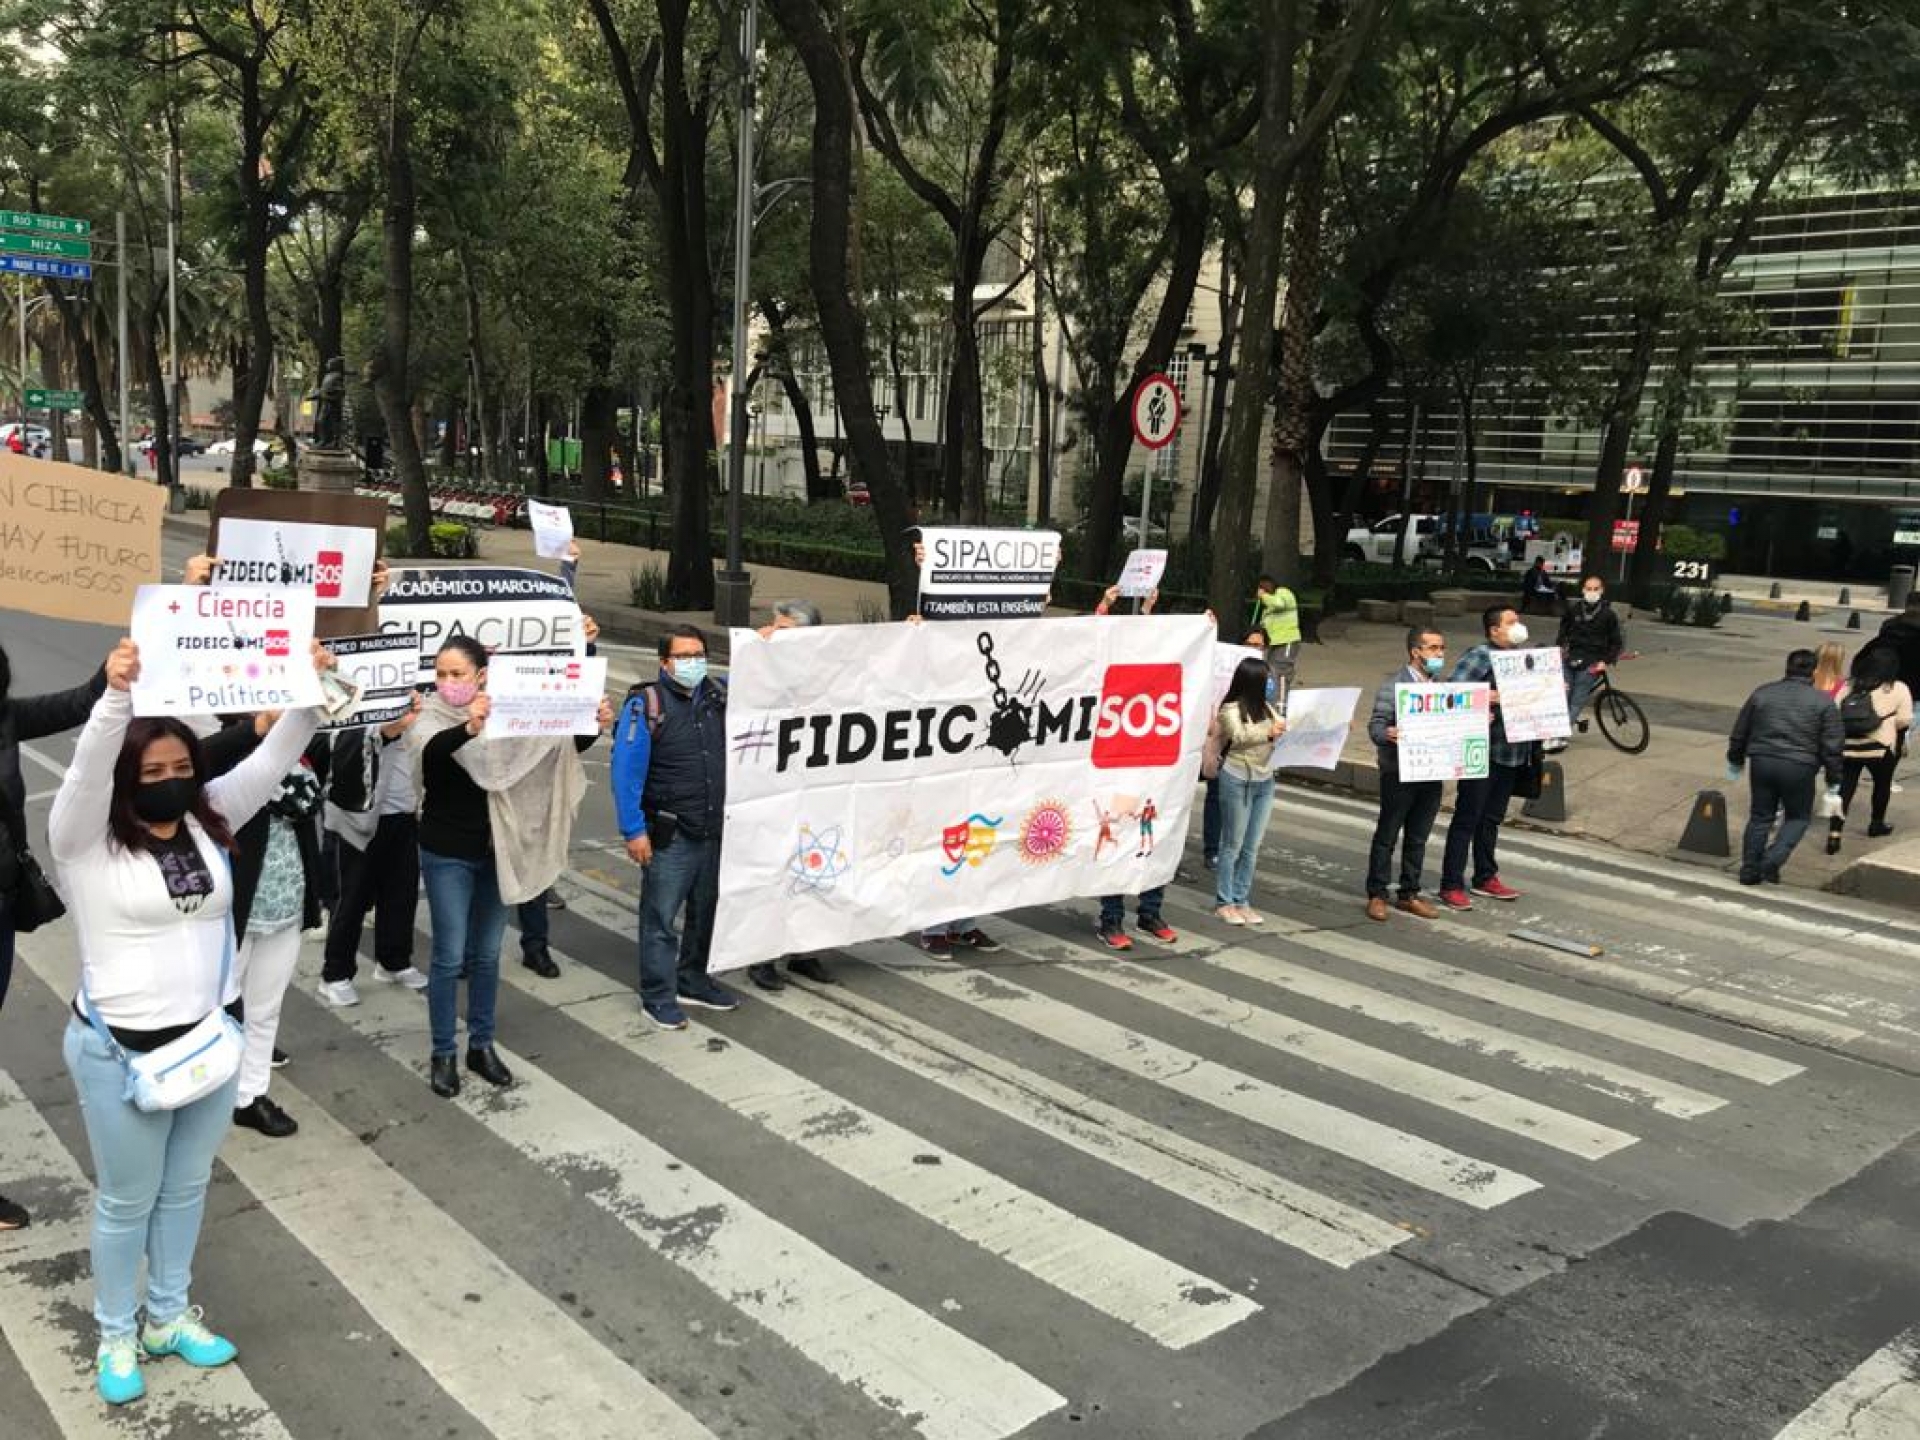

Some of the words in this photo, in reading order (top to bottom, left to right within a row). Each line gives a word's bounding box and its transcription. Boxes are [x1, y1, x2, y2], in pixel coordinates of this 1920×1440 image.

[13, 215, 30, 225] RIO
[32, 239, 61, 251] NIZA
[24, 482, 146, 526] CIENCIA
[934, 538, 1053, 569] SIPACIDE
[1673, 561, 1709, 580] 231
[389, 576, 484, 597] ACADÉMICO
[198, 591, 285, 618] Ciencia
[189, 683, 295, 708] Políticos
